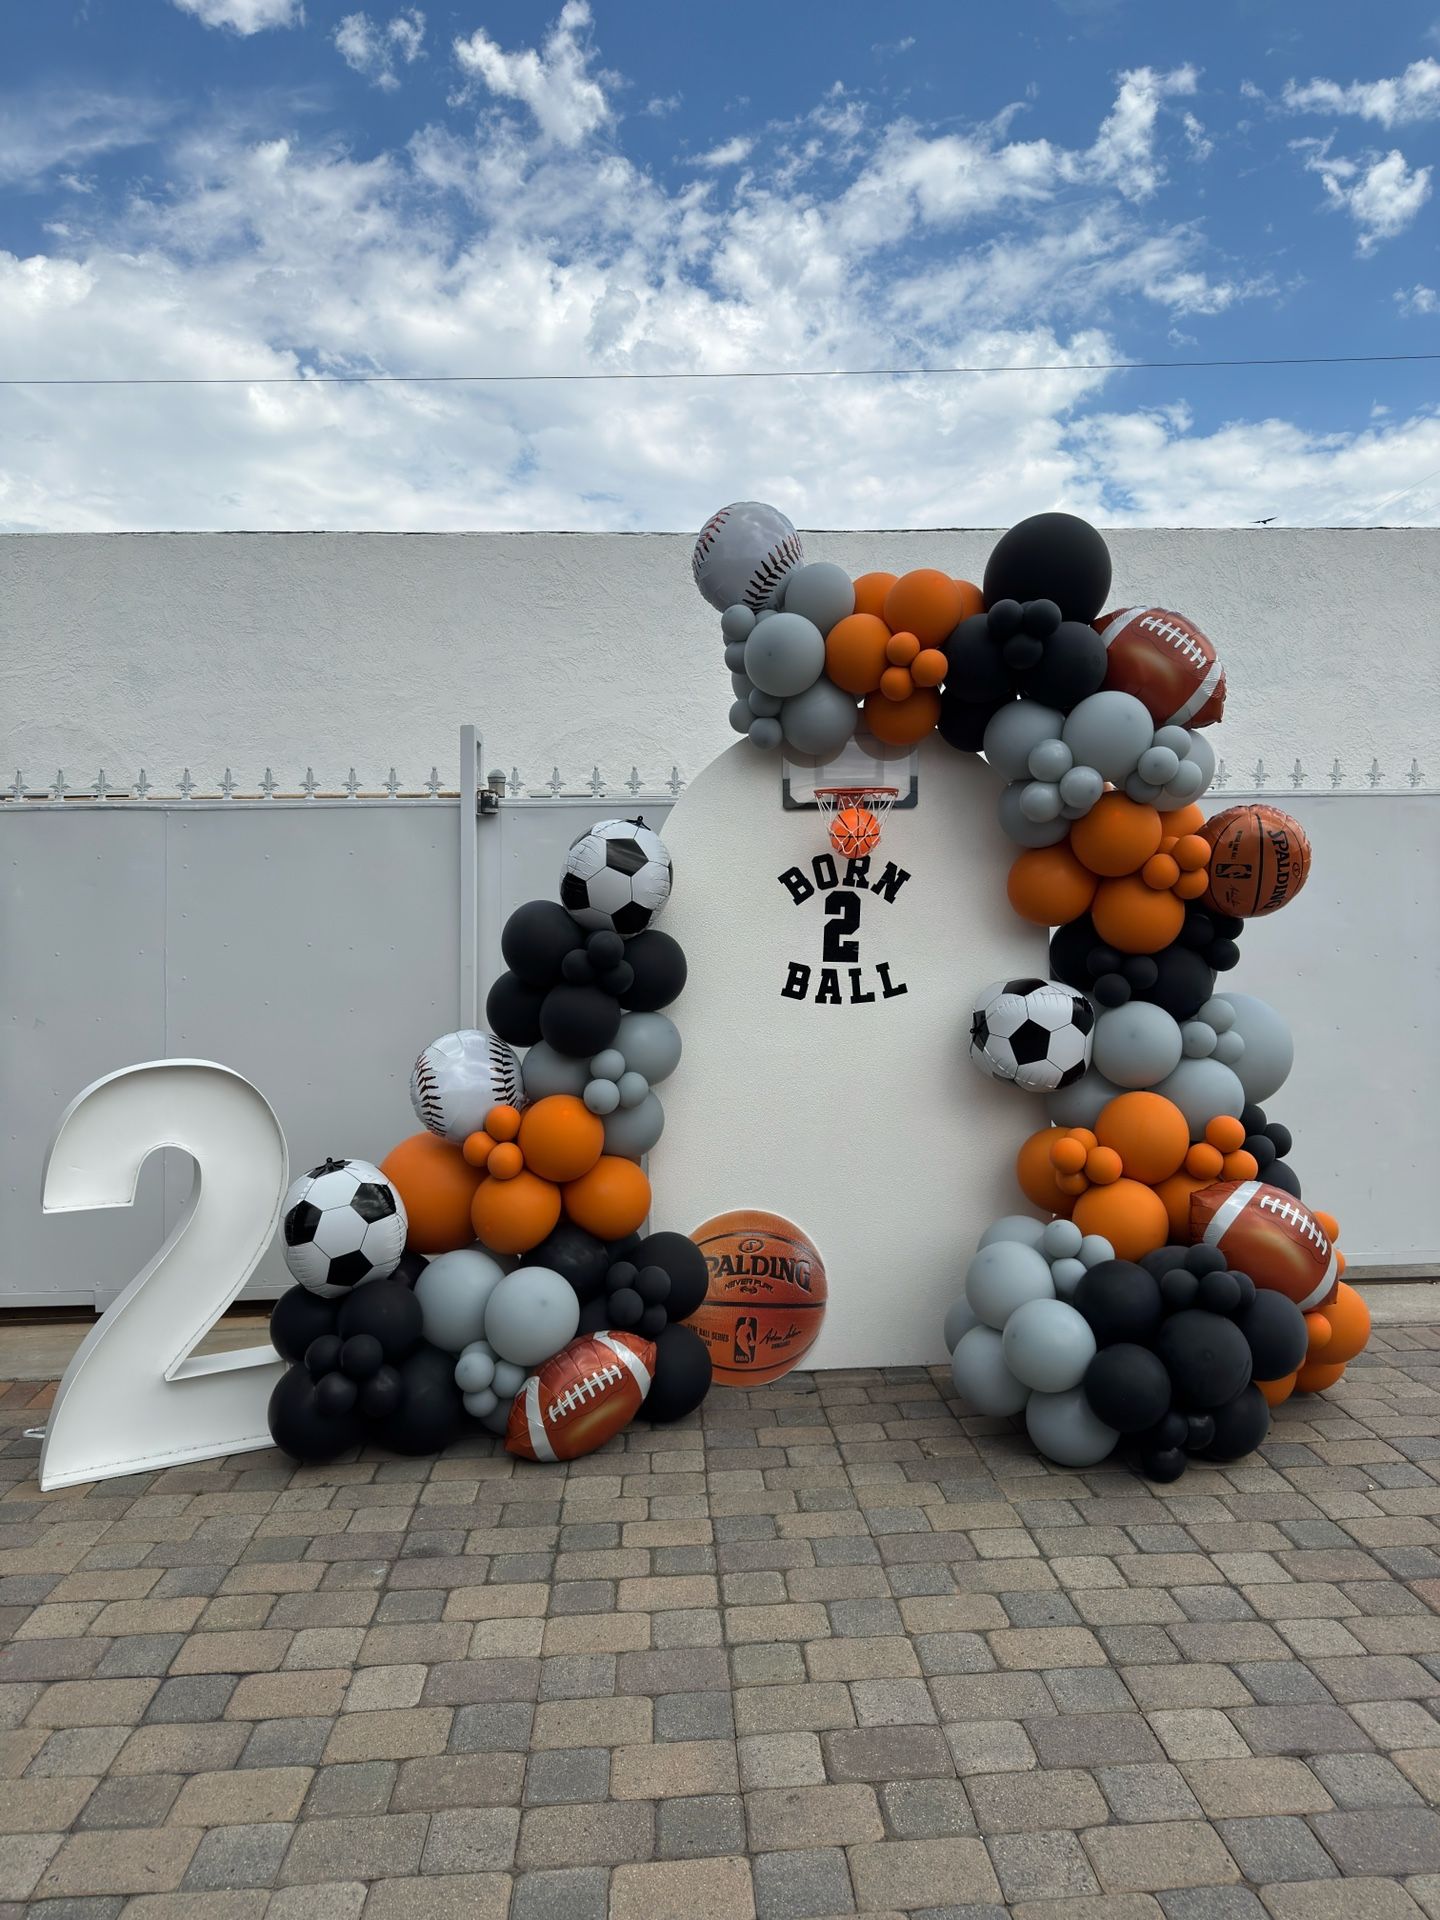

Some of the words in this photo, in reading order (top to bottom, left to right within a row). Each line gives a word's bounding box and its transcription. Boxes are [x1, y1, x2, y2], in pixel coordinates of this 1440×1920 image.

[777, 853, 912, 906] BORN
[1267, 830, 1291, 909] SPALDING
[822, 890, 861, 963] 2
[780, 961, 908, 1005] BALL
[40, 1058, 289, 1492] 2
[704, 1254, 812, 1292] PALDING
